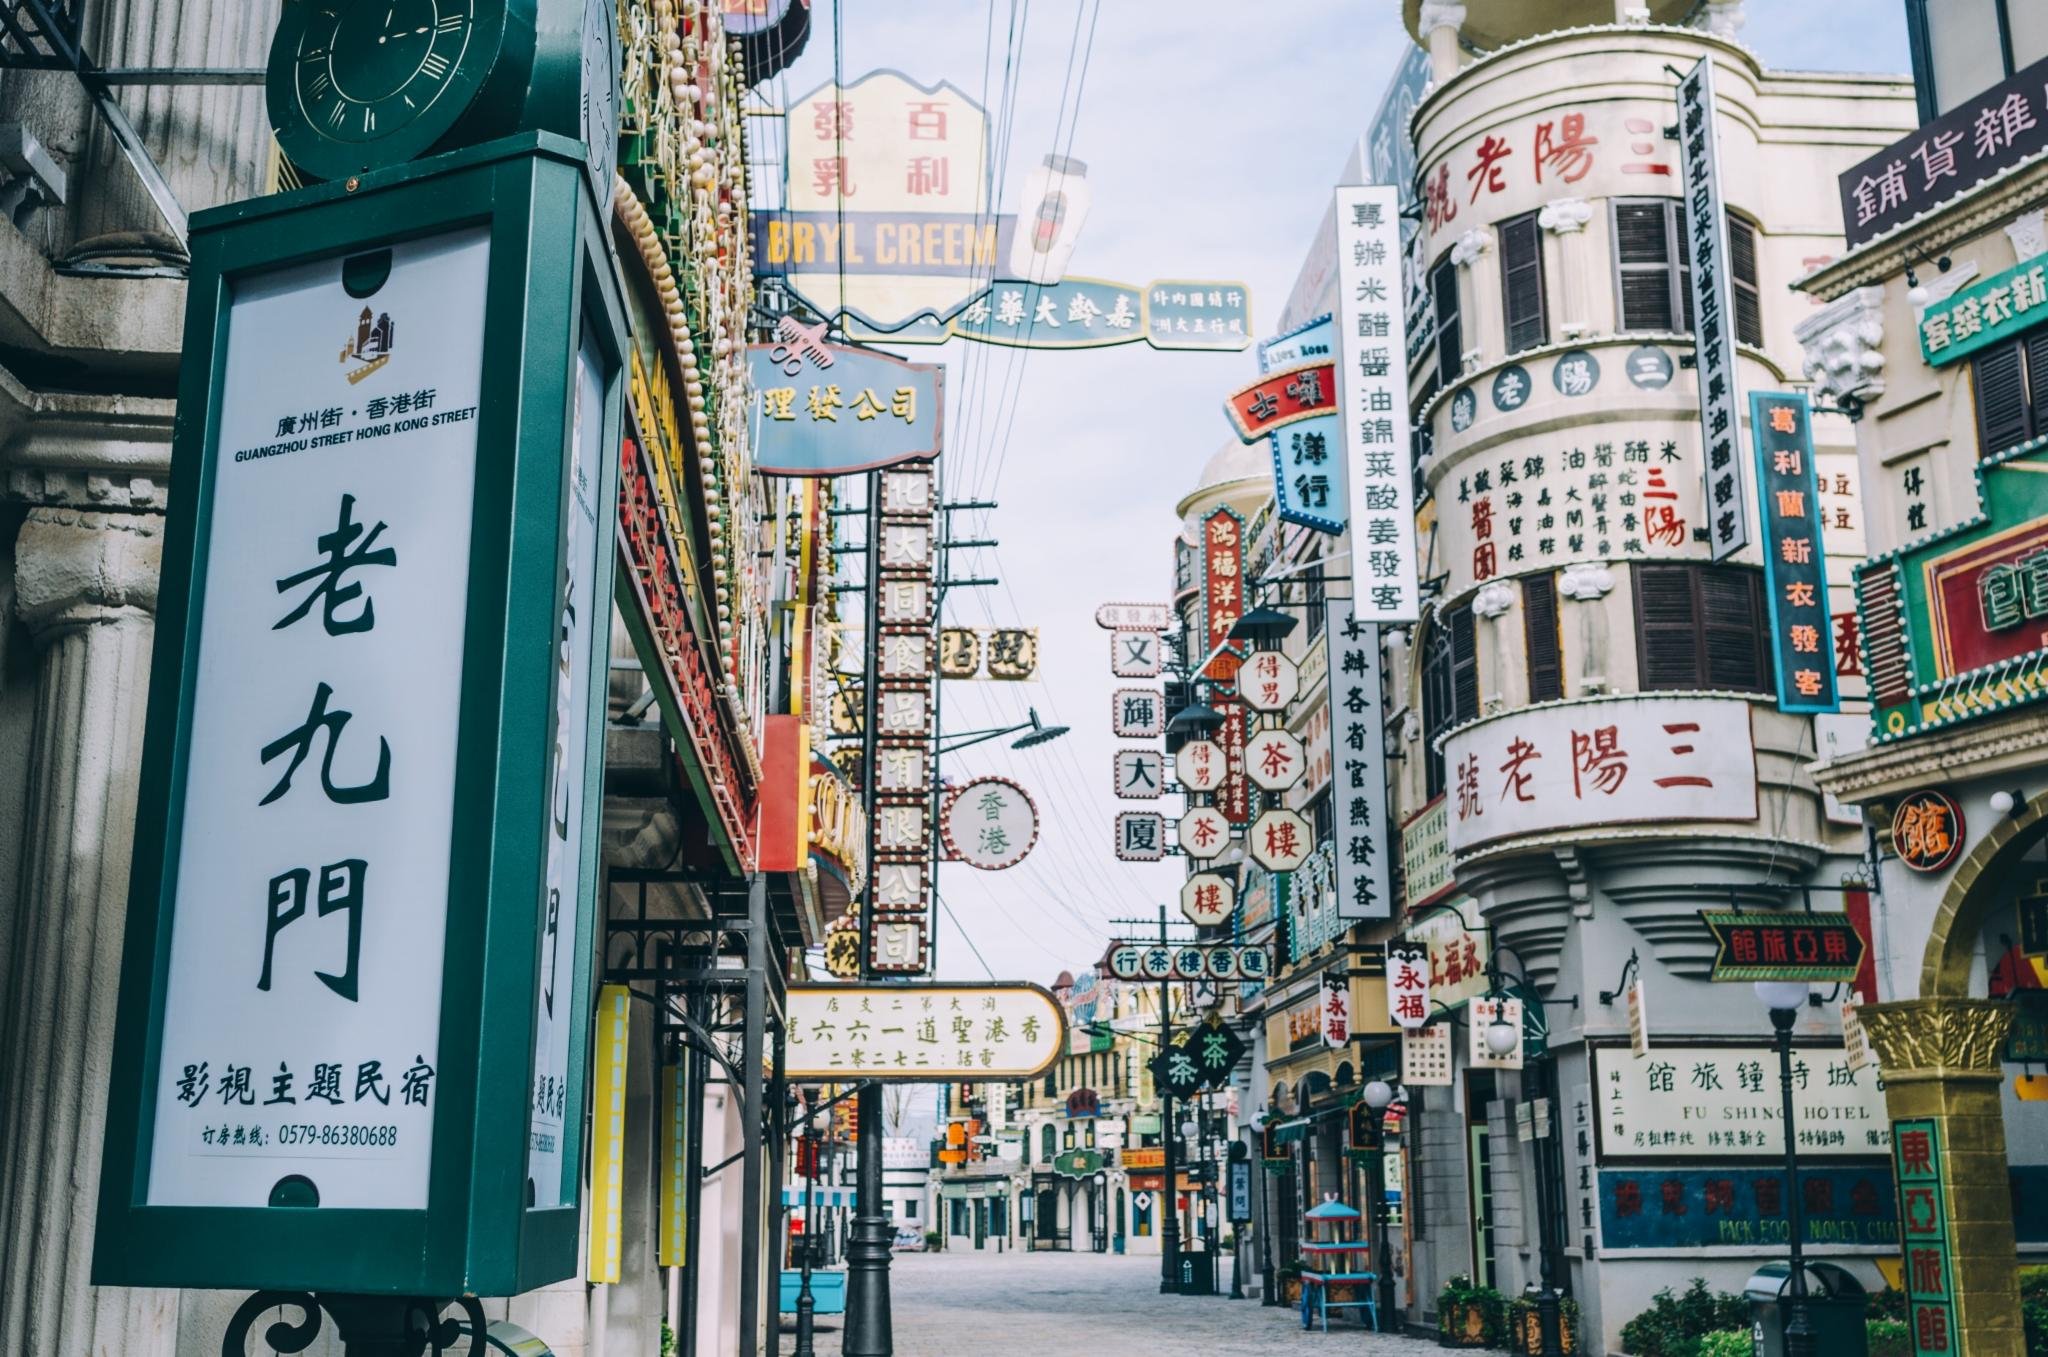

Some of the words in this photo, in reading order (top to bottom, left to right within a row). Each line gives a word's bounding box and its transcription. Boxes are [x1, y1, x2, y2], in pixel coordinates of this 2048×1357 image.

[767, 221, 864, 265] BRYL
[875, 222, 998, 267] CREEM
[234, 437, 308, 463] GUANGZHOU
[310, 430, 354, 449] STREET
[355, 424, 391, 441] HONG
[393, 416, 428, 433] KONG
[431, 406, 477, 426] STREET
[1291, 431, 1330, 508] 洋行
[256, 493, 397, 1003] 老九門
[976, 789, 1011, 855] 香港
[1326, 992, 1348, 1042] 永福
[1394, 964, 1426, 1019] 永福
[1168, 1052, 1199, 1086] 茶
[1203, 1033, 1229, 1069] 茶
[176, 1054, 436, 1108] 影視主題民宿
[278, 1124, 398, 1147] 0579-86380688
[1683, 1106, 1709, 1120] FU
[1803, 1105, 1871, 1120] HOTEL
